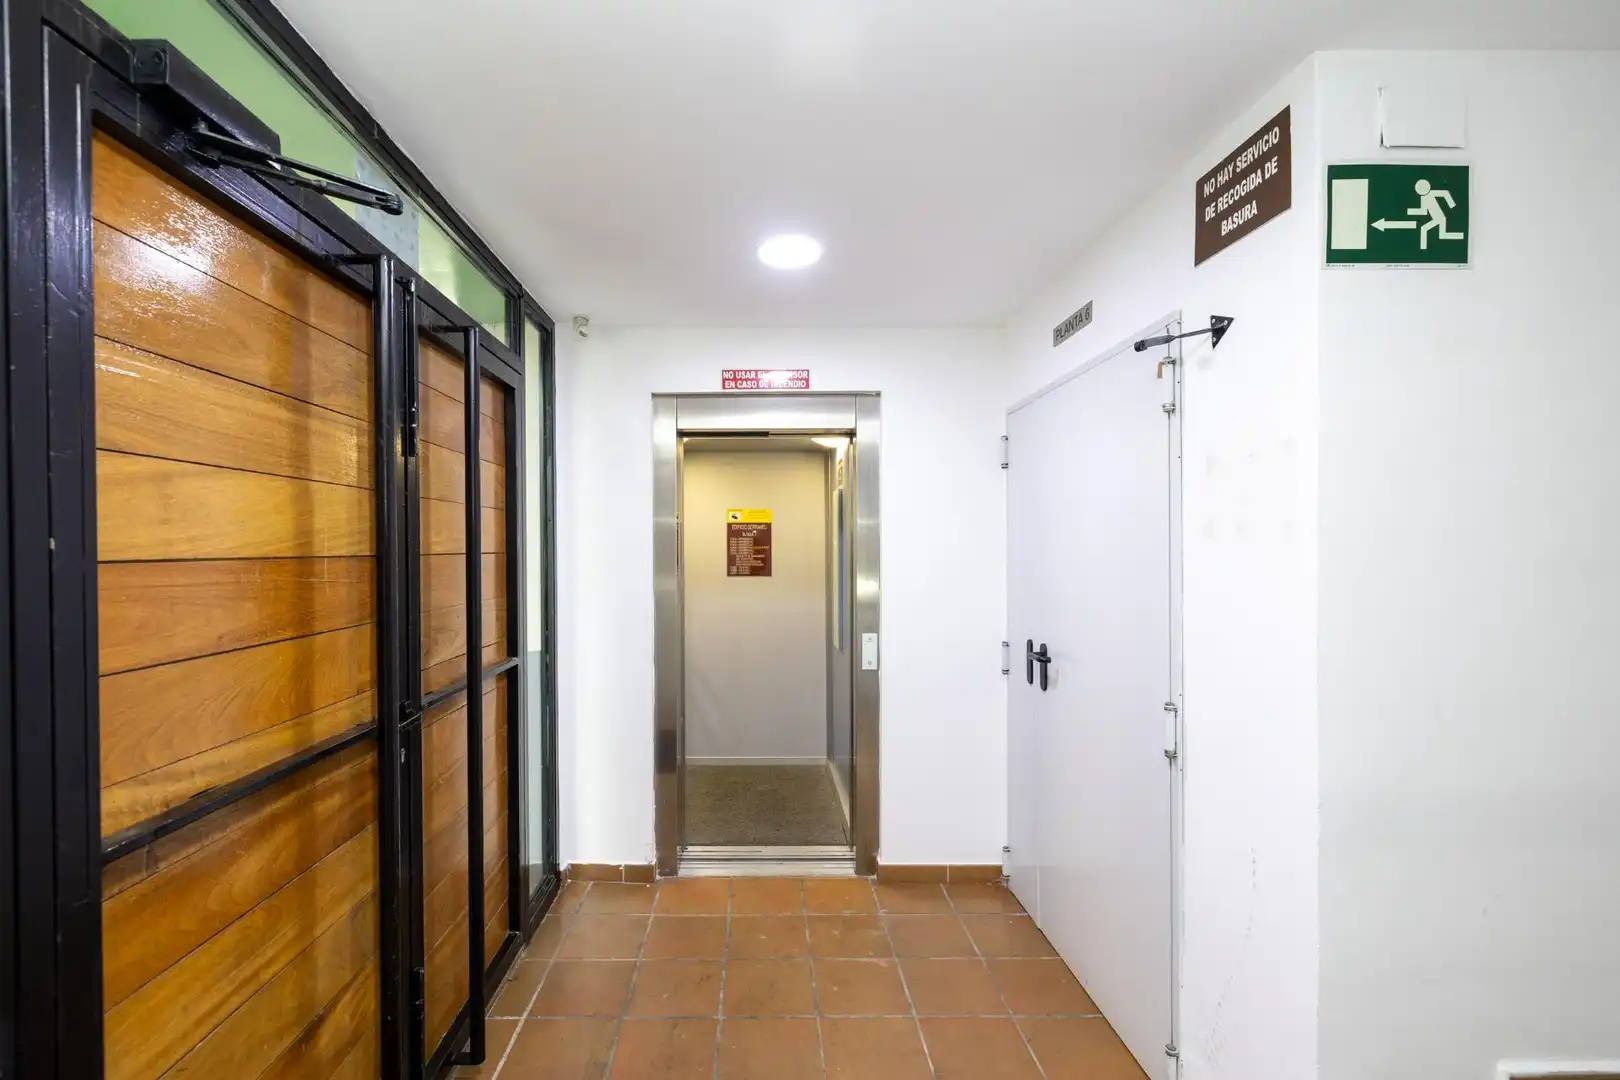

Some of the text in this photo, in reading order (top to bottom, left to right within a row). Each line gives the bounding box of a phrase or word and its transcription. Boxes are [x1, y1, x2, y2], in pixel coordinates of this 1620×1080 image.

[1203, 126, 1280, 198] NO HAY SERVICIO
[1205, 156, 1278, 222] DE RECOGIDA DE
[1221, 200, 1258, 236] BASURA
[1055, 307, 1090, 341] PLANTA 6
[723, 371, 734, 379] NO
[735, 371, 756, 379] USAR
[725, 380, 736, 388] EN
[737, 380, 757, 388] CASO
[758, 380, 769, 388] DE
